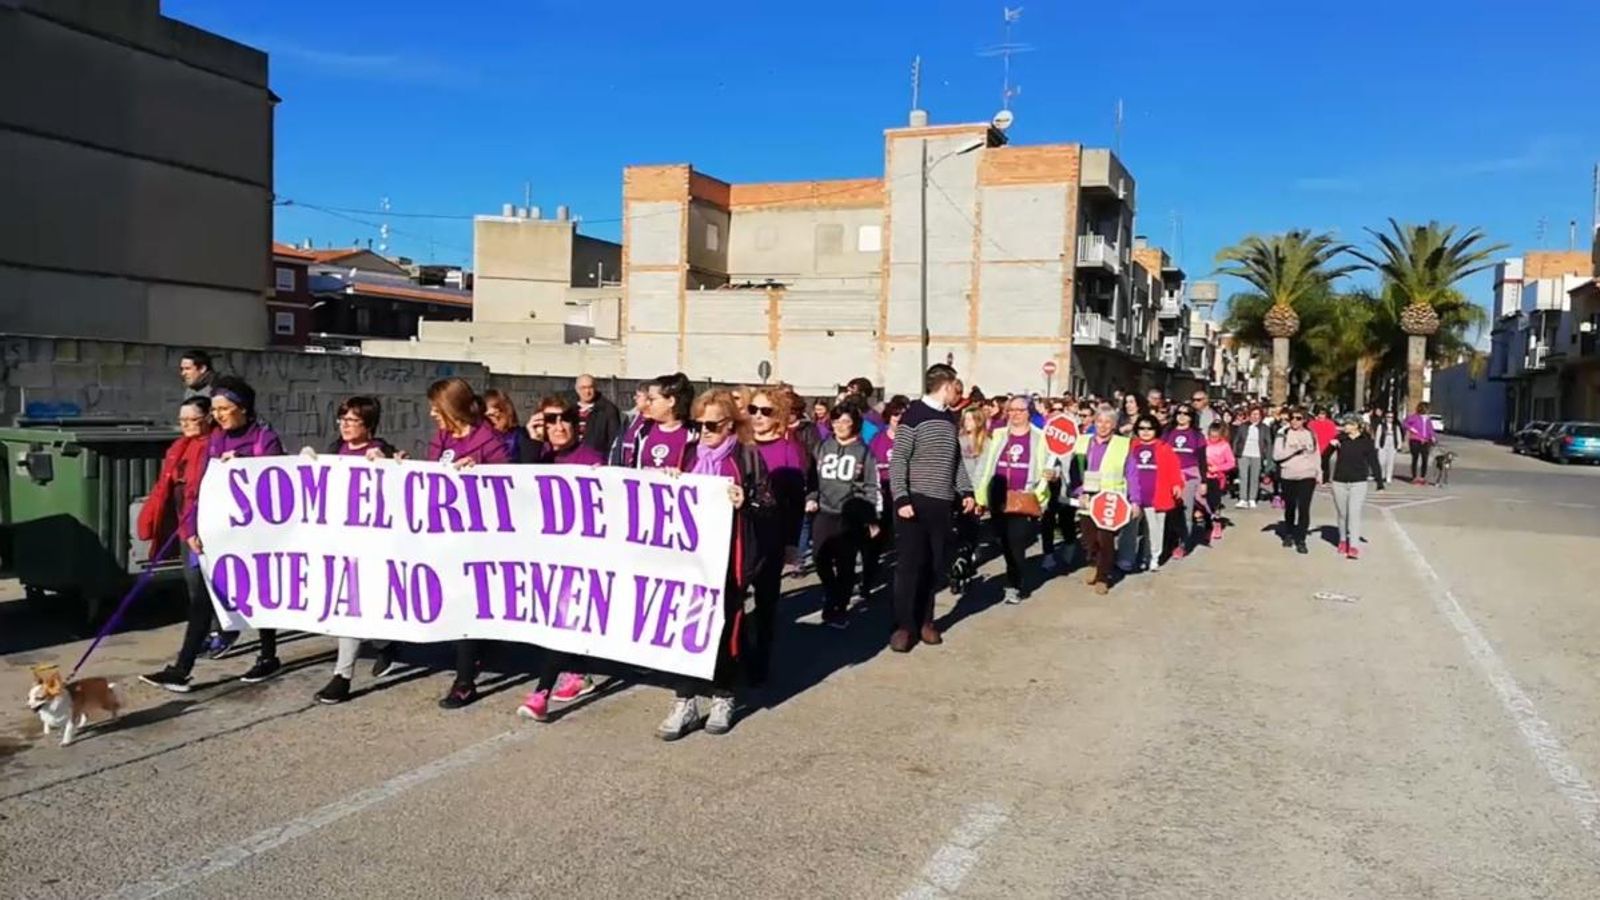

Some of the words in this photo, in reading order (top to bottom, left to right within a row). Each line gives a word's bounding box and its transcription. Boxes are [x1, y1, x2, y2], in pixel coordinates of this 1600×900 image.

[1046, 426, 1077, 446] STOP
[821, 453, 856, 481] 20
[229, 466, 331, 526] SOM
[345, 467, 392, 529] EL
[404, 470, 515, 533] CRIT
[535, 475, 607, 538] DE
[624, 479, 700, 553] LES
[1103, 492, 1118, 527] STOP
[211, 552, 308, 617] QUE
[320, 555, 361, 622] JA
[384, 560, 443, 623] NO
[463, 561, 616, 634] TENEN
[633, 575, 721, 655] VEU
